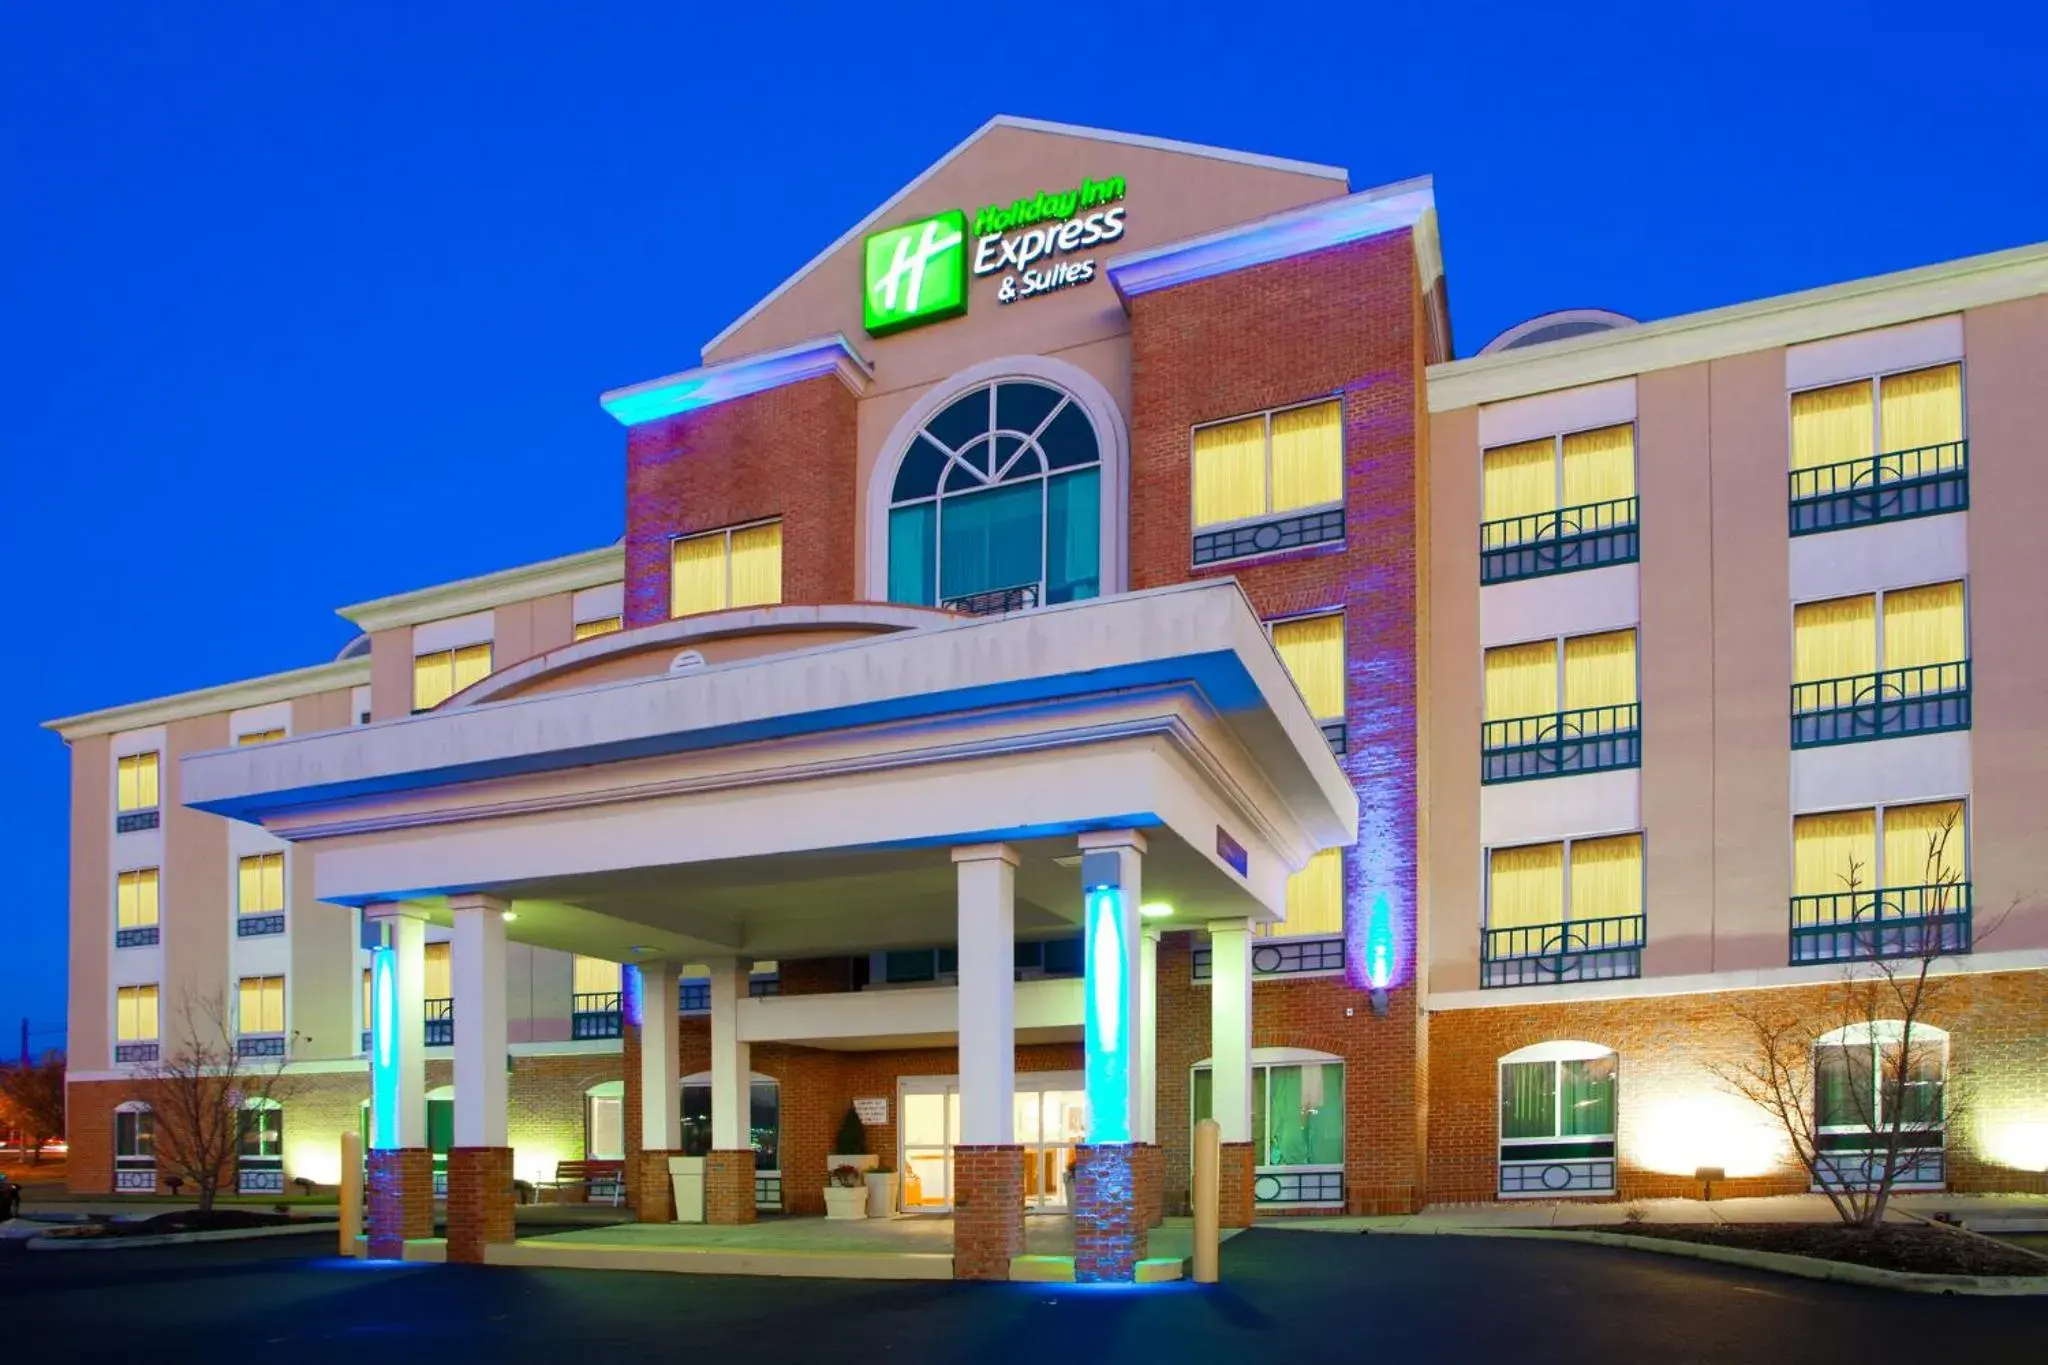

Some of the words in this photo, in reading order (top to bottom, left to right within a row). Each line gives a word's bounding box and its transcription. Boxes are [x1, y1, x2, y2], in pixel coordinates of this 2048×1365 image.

[973, 188, 1077, 236] Holiday
[1080, 175, 1126, 205] Inn
[873, 220, 962, 313] H
[973, 206, 1125, 274] Express
[998, 276, 1016, 302] &
[1020, 260, 1094, 295] Suites
